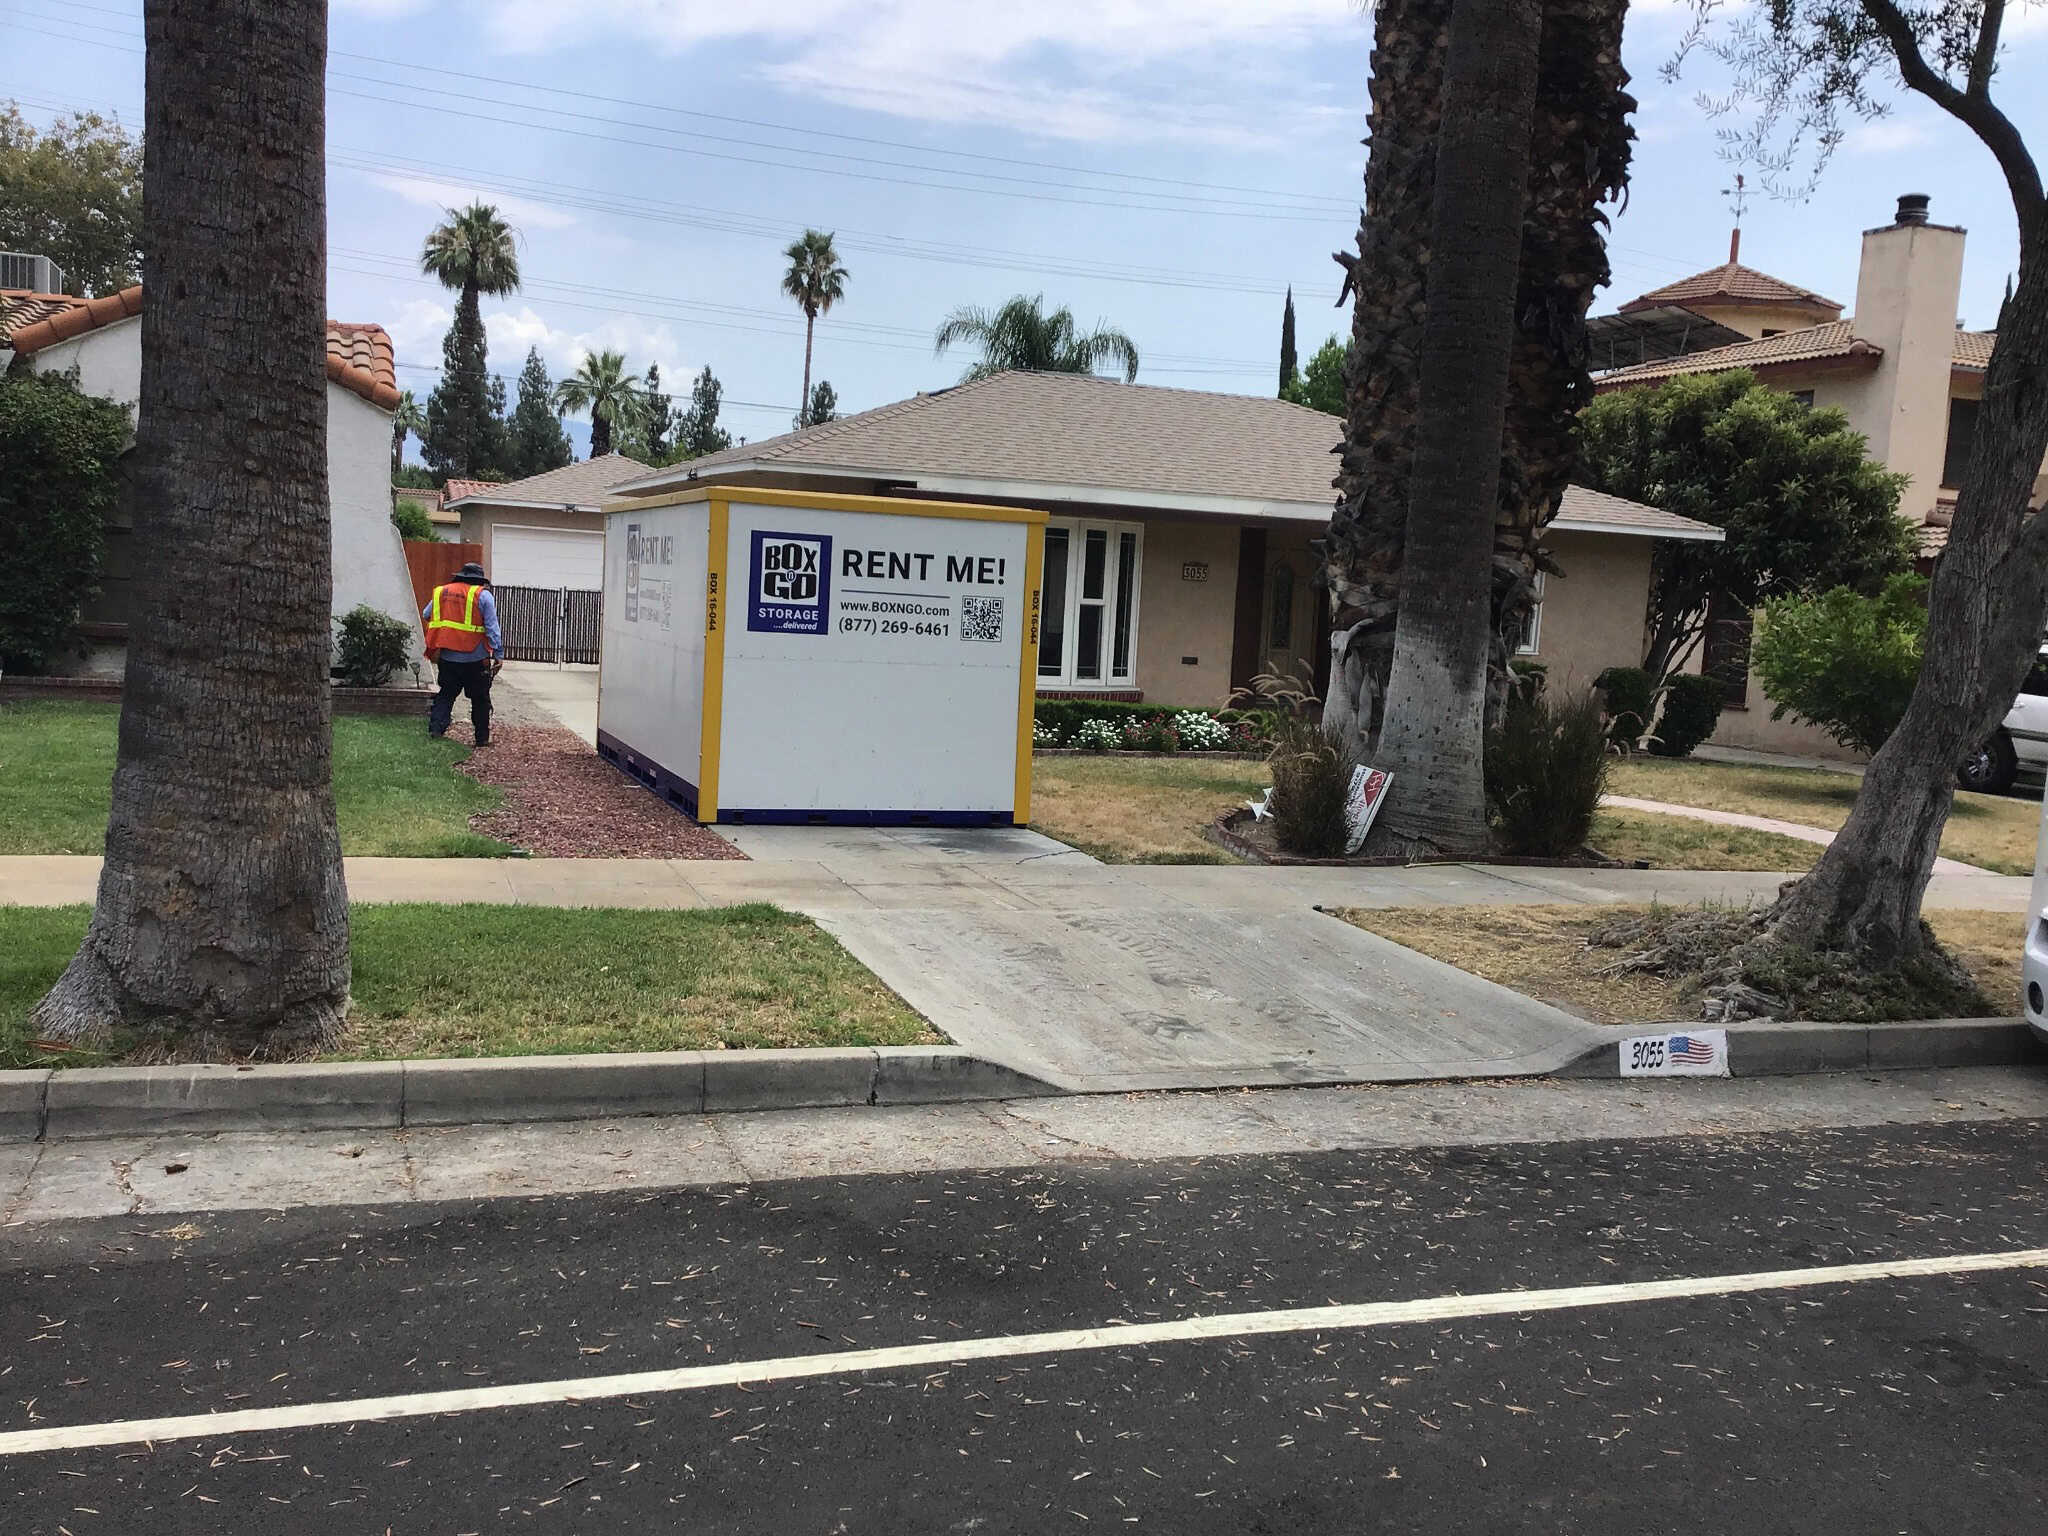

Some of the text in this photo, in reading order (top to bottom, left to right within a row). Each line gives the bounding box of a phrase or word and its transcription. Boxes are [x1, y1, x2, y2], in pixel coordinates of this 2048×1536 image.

[640, 535, 659, 565] RENT
[764, 543, 818, 573] BOX
[842, 549, 1006, 585] RENT ME!
[1184, 567, 1208, 579] 3055
[763, 571, 817, 601] GO
[1032, 590, 1040, 611] BOX
[709, 572, 718, 631] BOX 16-044
[758, 607, 819, 621] STORAGE
[840, 601, 950, 617] www.BOXNGO.com
[838, 617, 950, 637] (877) 269-6461
[1631, 1041, 1665, 1070] 3055
